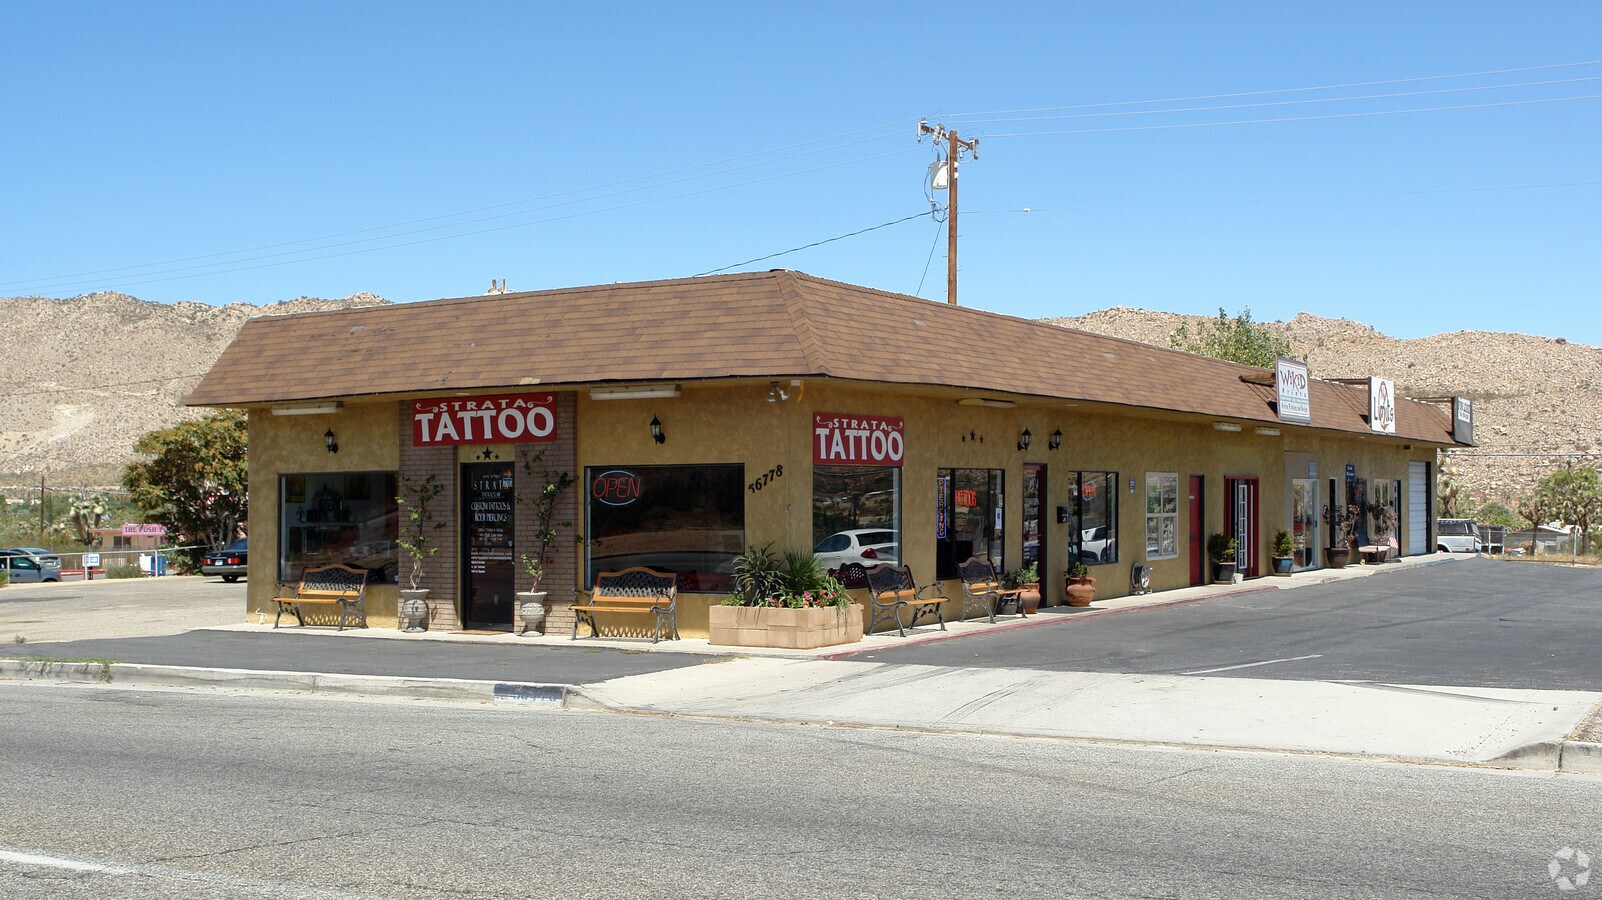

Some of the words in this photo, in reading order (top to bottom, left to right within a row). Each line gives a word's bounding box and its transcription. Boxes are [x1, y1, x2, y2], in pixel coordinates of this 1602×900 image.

[439, 398, 527, 412] STRATA
[414, 406, 554, 442] TATTOO
[833, 418, 888, 431] STRATA
[815, 427, 904, 461] TATTOO
[592, 477, 641, 498] OPEN
[748, 464, 784, 494] 56778
[1082, 485, 1097, 497] OPEN
